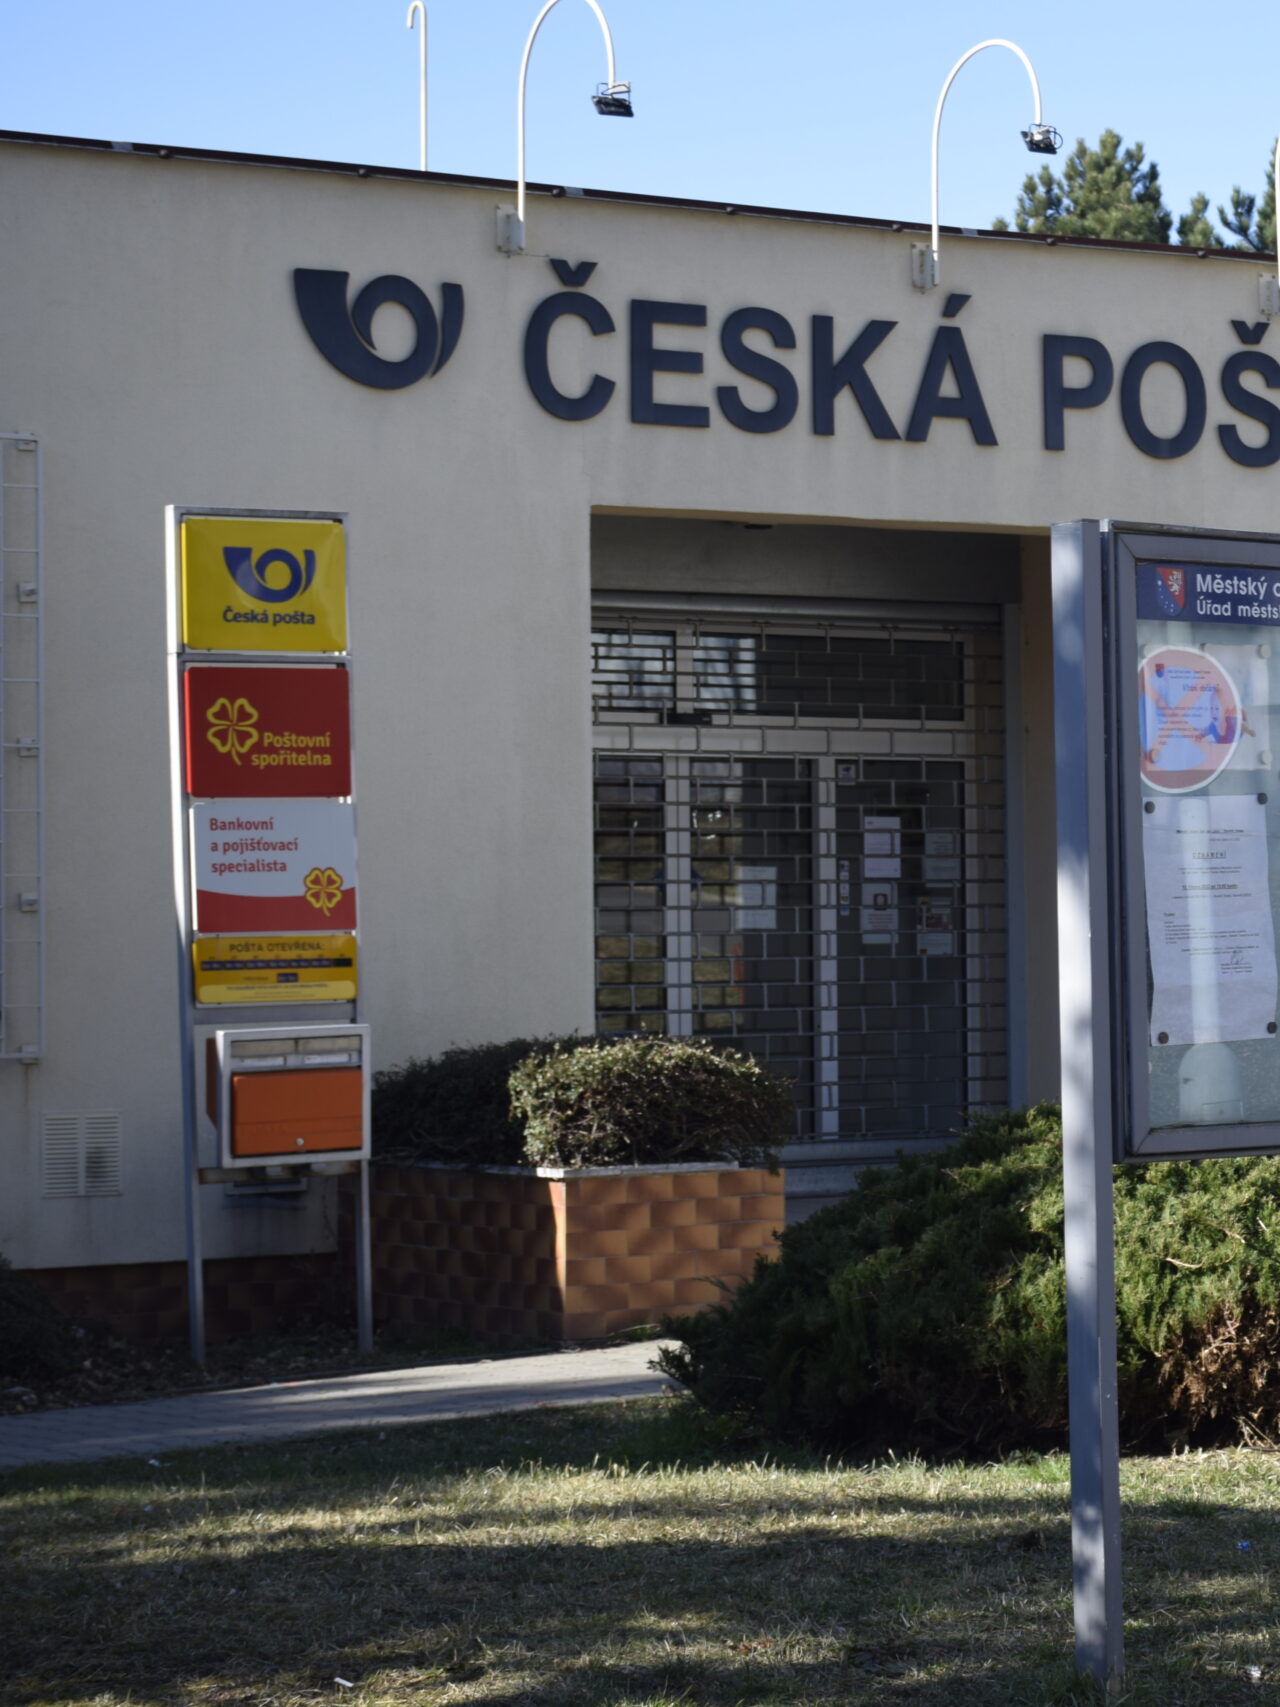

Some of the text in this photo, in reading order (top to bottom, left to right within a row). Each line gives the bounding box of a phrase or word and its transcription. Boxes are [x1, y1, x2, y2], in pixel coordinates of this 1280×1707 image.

[524, 259, 998, 447] ČESKÁ
[1196, 573, 1267, 599] Městský
[1196, 596, 1231, 616] Úřad
[223, 606, 316, 627] Česká pošta
[263, 732, 331, 748] Poštovní
[252, 751, 332, 769] spořitelna
[209, 816, 274, 831] Bankovní
[210, 837, 299, 855] a pojišťovací
[211, 859, 287, 876] specialista
[229, 942, 265, 952] POŠTA
